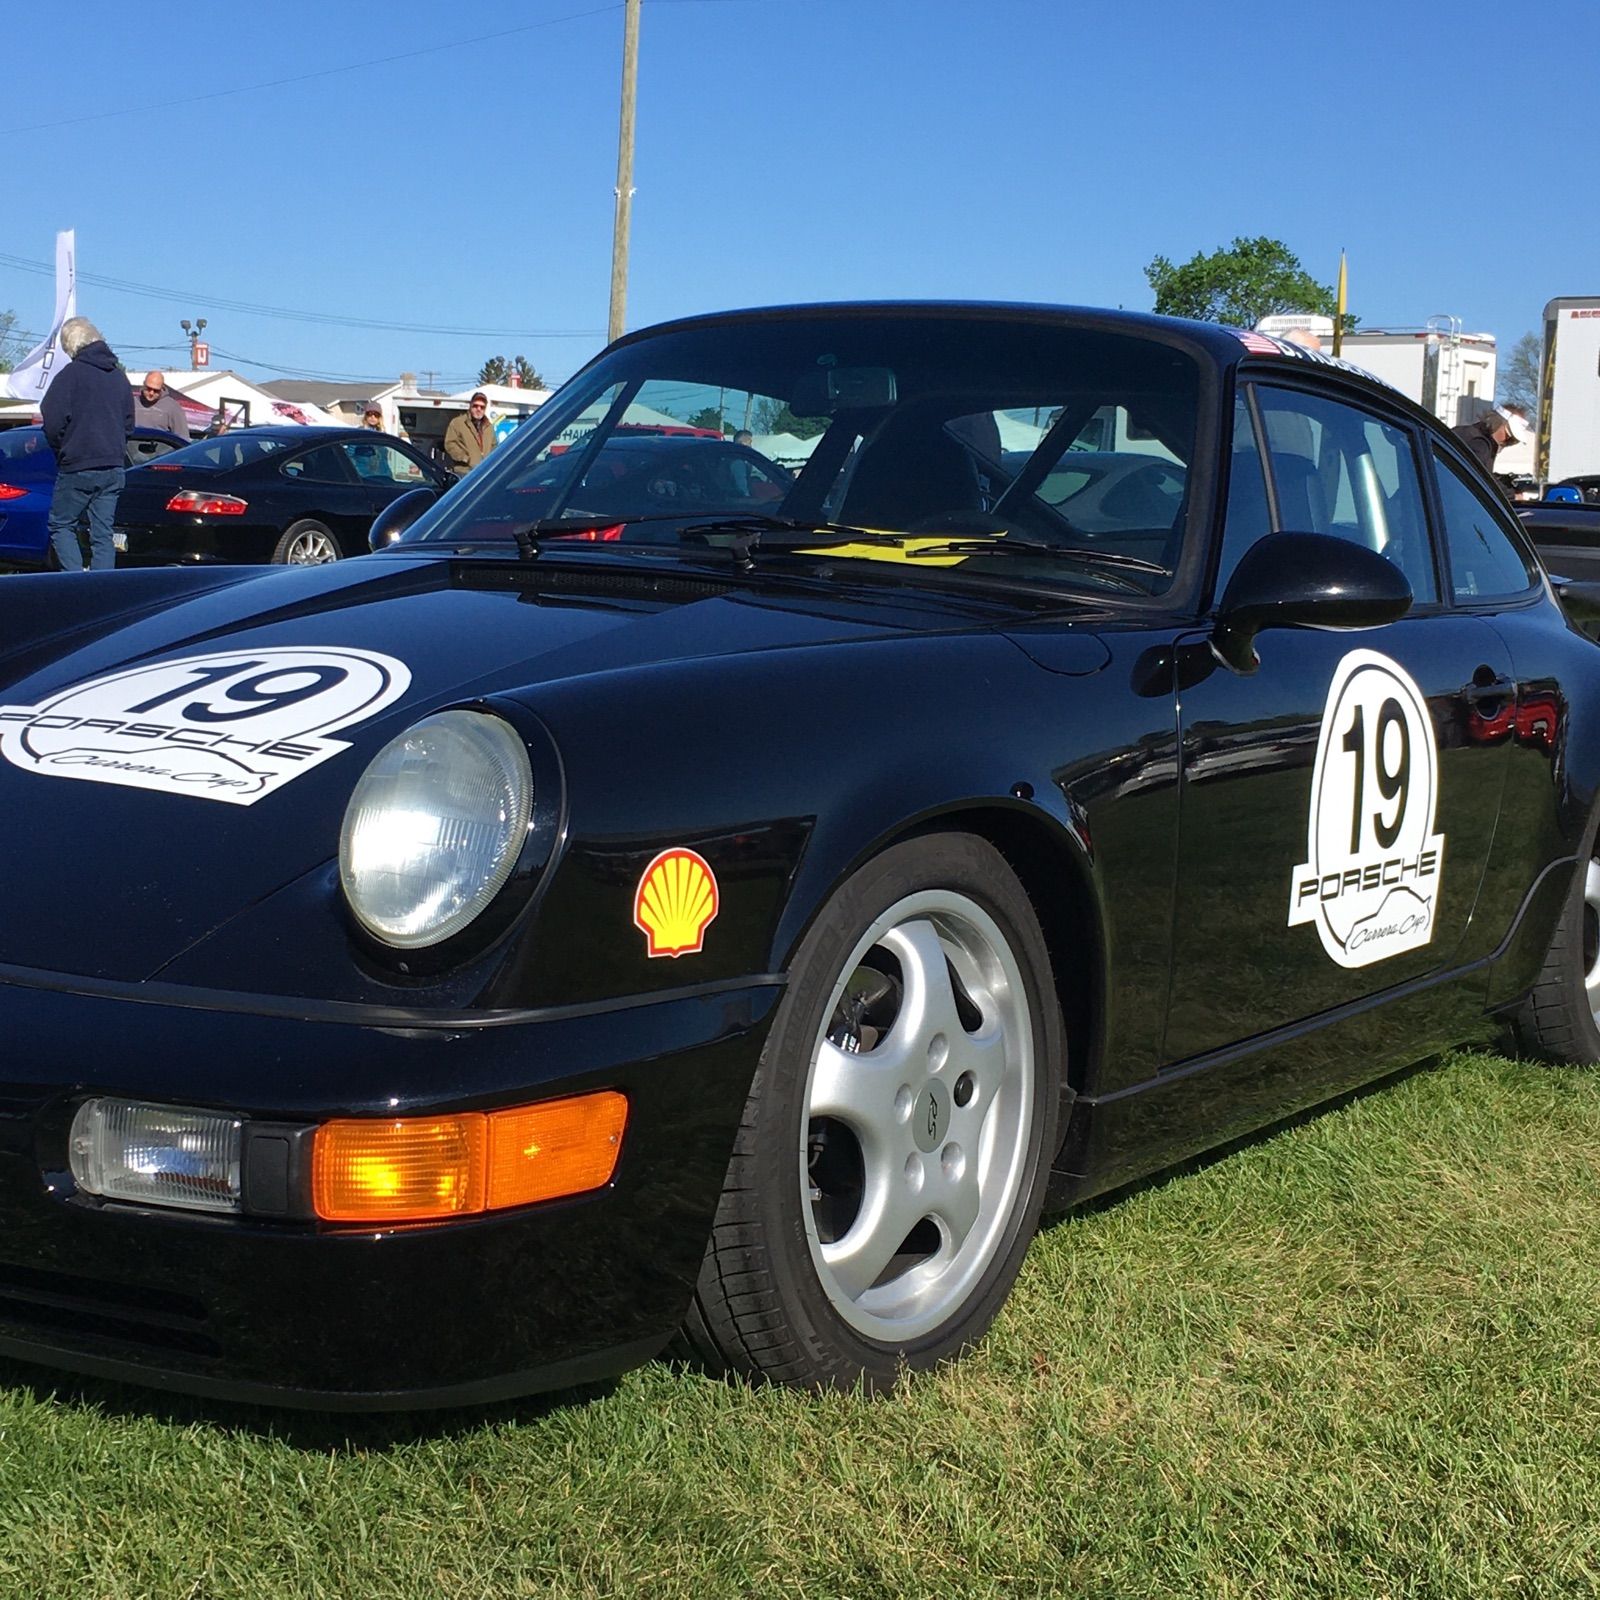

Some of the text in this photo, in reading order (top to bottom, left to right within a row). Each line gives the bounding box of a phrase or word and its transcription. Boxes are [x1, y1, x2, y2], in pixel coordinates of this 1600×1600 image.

[122, 661, 349, 722] 19
[0, 712, 323, 761] PORSCHE
[50, 755, 249, 788] Carrera Cup
[1343, 697, 1411, 855] 19
[1298, 850, 1437, 908] PORSCHE
[1350, 914, 1426, 949] Carrera Cup
